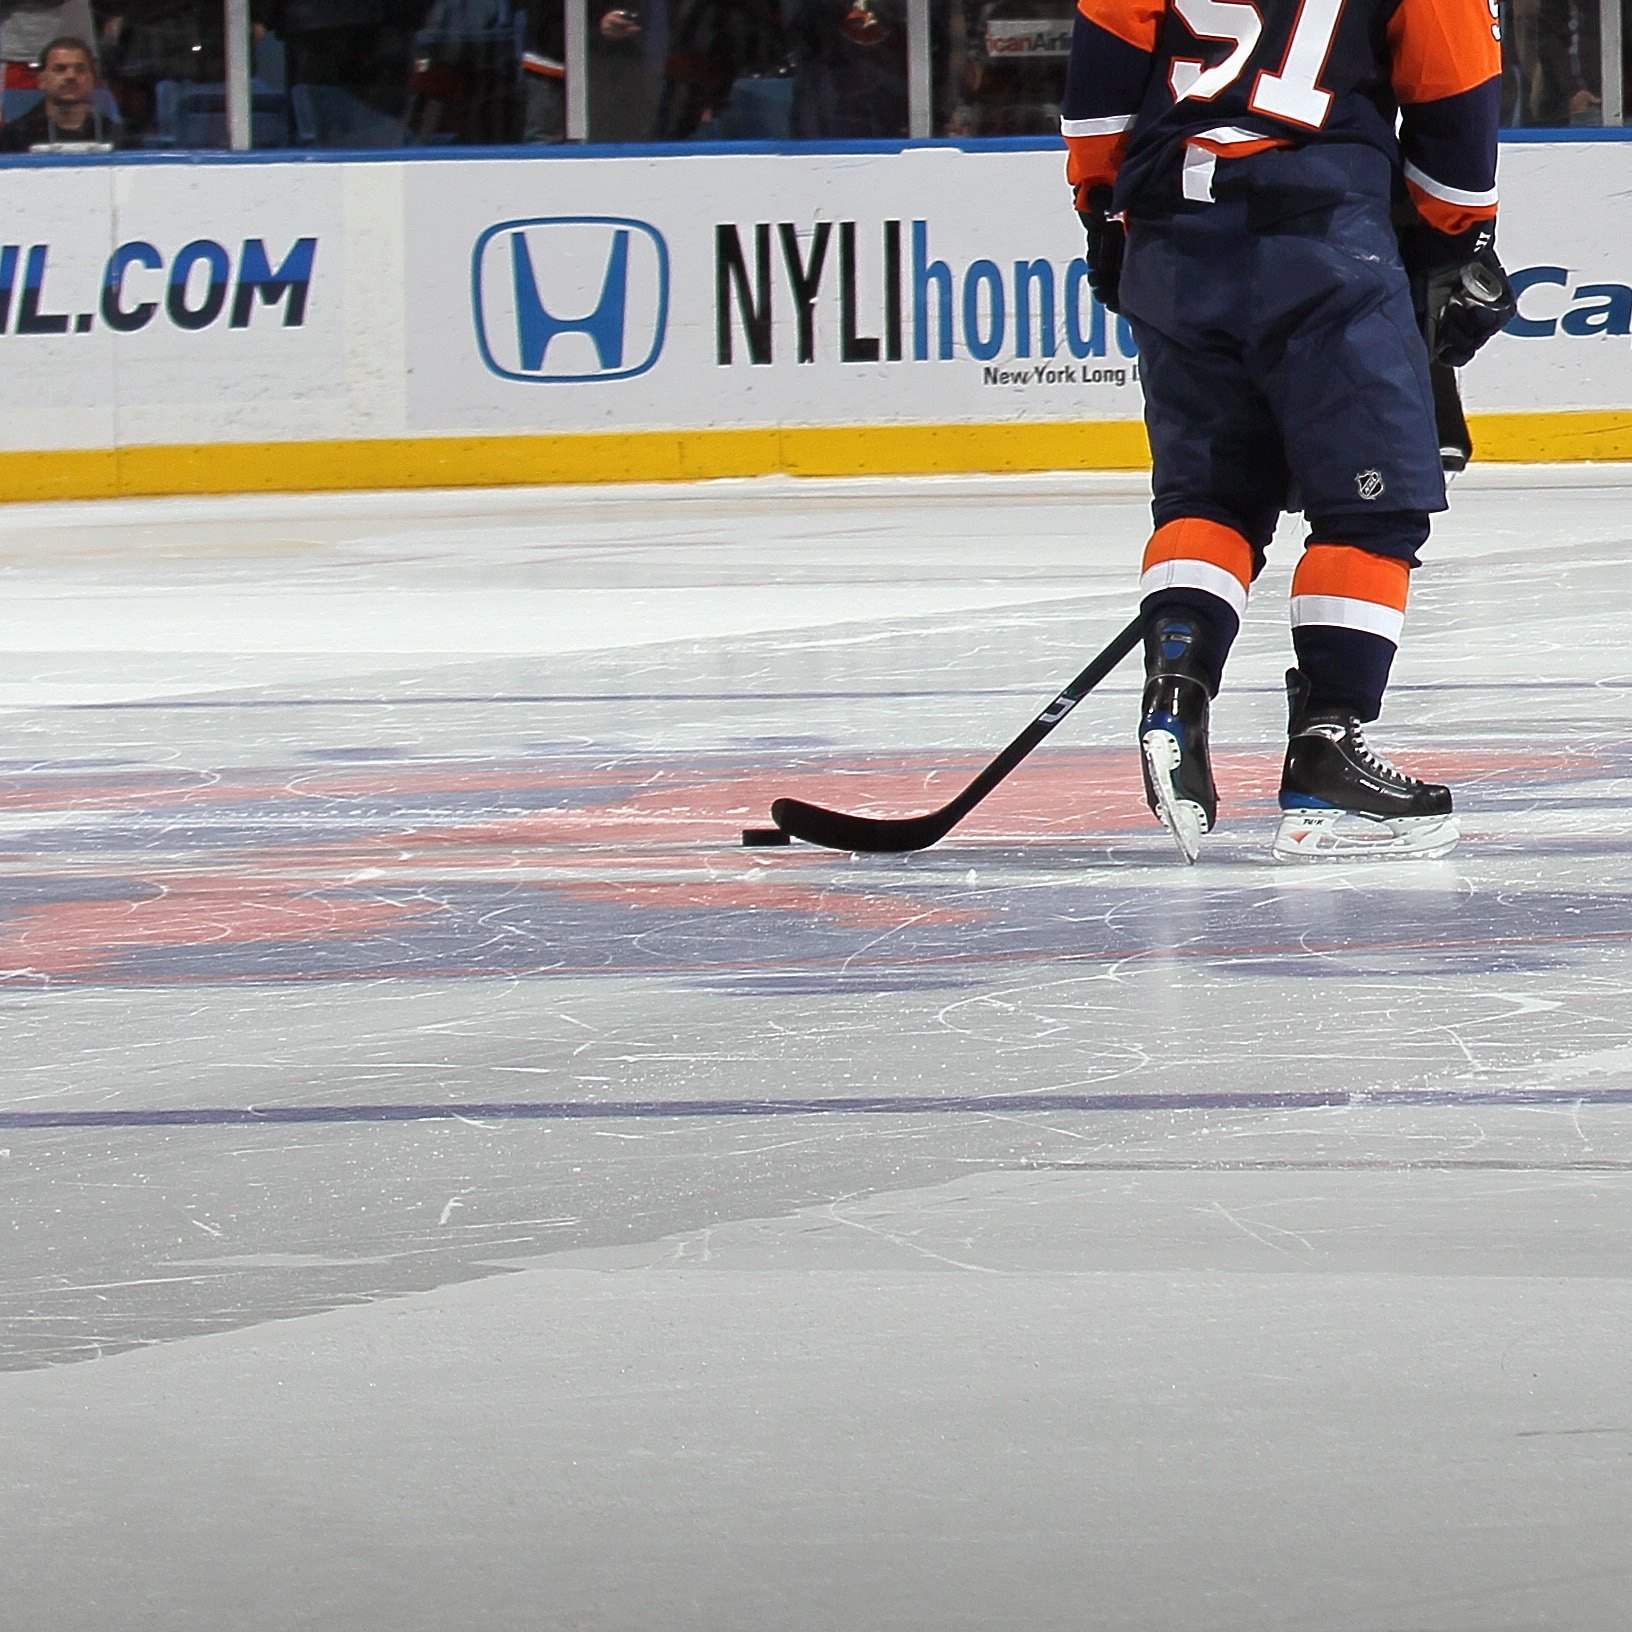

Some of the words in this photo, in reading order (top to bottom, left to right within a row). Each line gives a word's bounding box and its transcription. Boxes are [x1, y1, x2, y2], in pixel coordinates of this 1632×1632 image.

[984, 367, 1032, 386] New
[1032, 365, 1079, 385] York
[1081, 364, 1126, 387] Long
